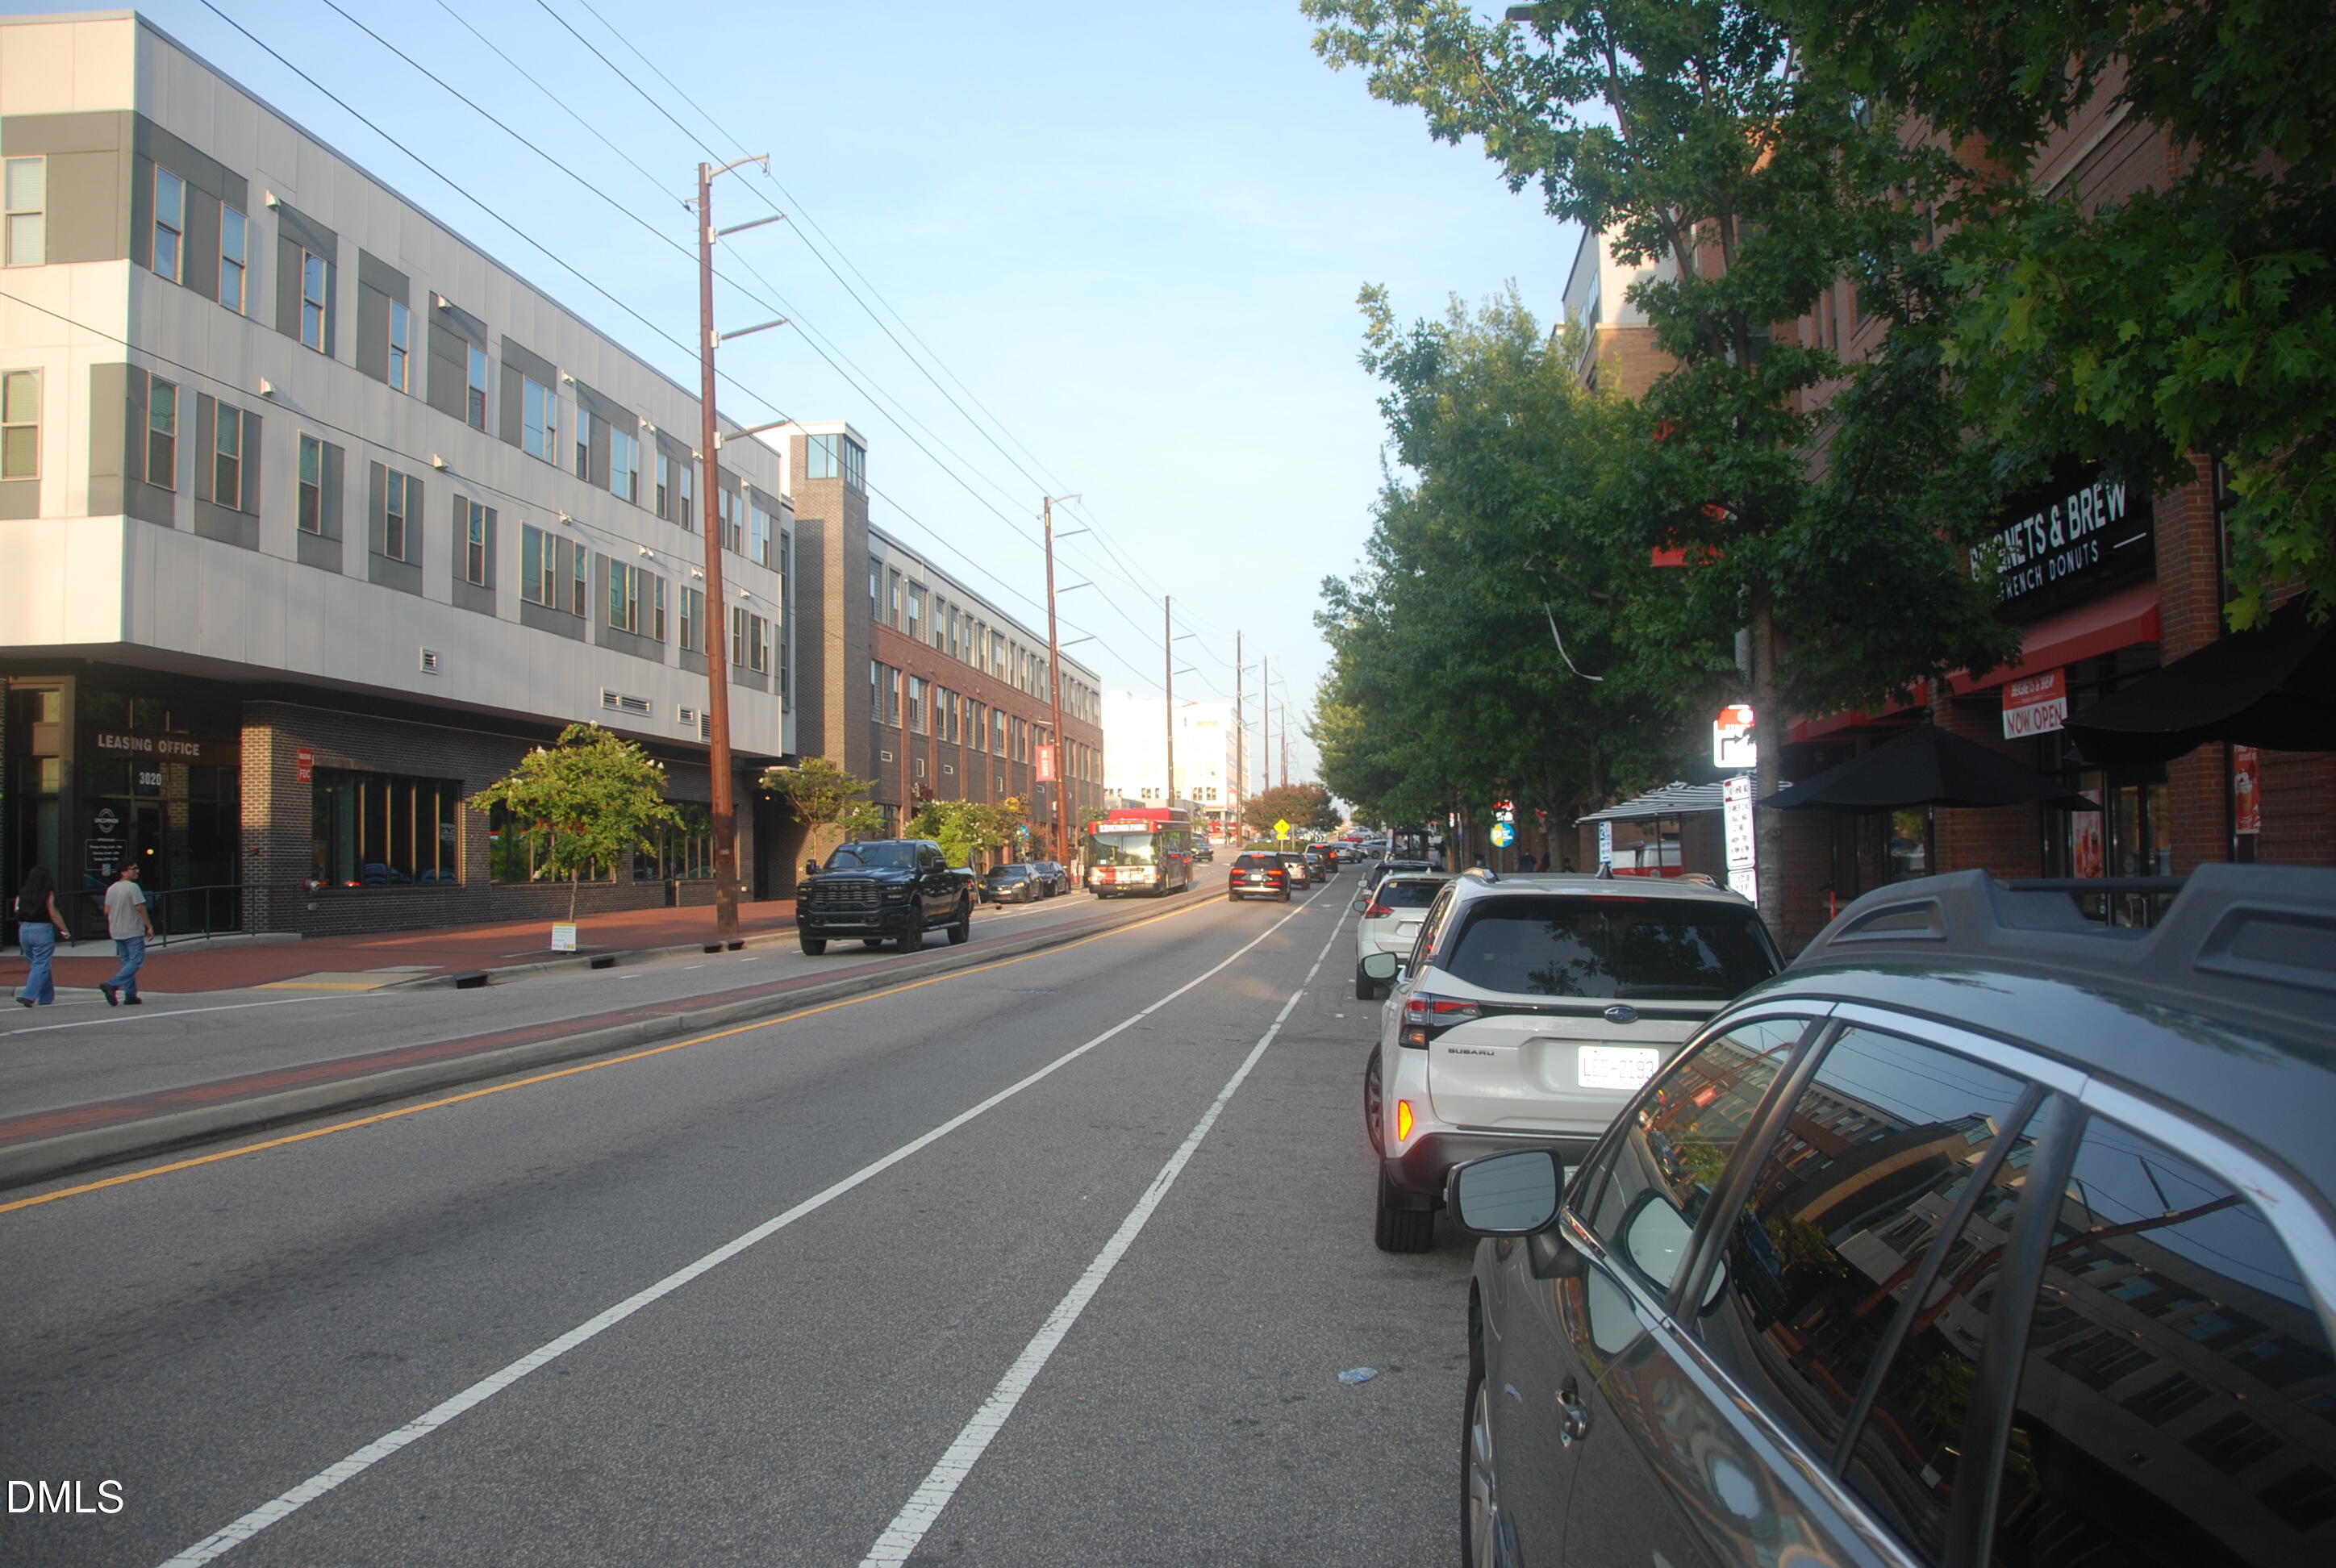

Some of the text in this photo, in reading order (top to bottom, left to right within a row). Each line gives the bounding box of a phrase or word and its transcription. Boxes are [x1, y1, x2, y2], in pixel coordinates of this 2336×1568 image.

[1969, 479, 2125, 582] BGNETS & BREW
[2050, 540, 2098, 581] DONUTS
[2007, 703, 2063, 734] NOW OPEN
[98, 733, 200, 757] LEASING OFFICE
[139, 771, 162, 786] 3020
[1448, 1048, 1495, 1056] SUBARU
